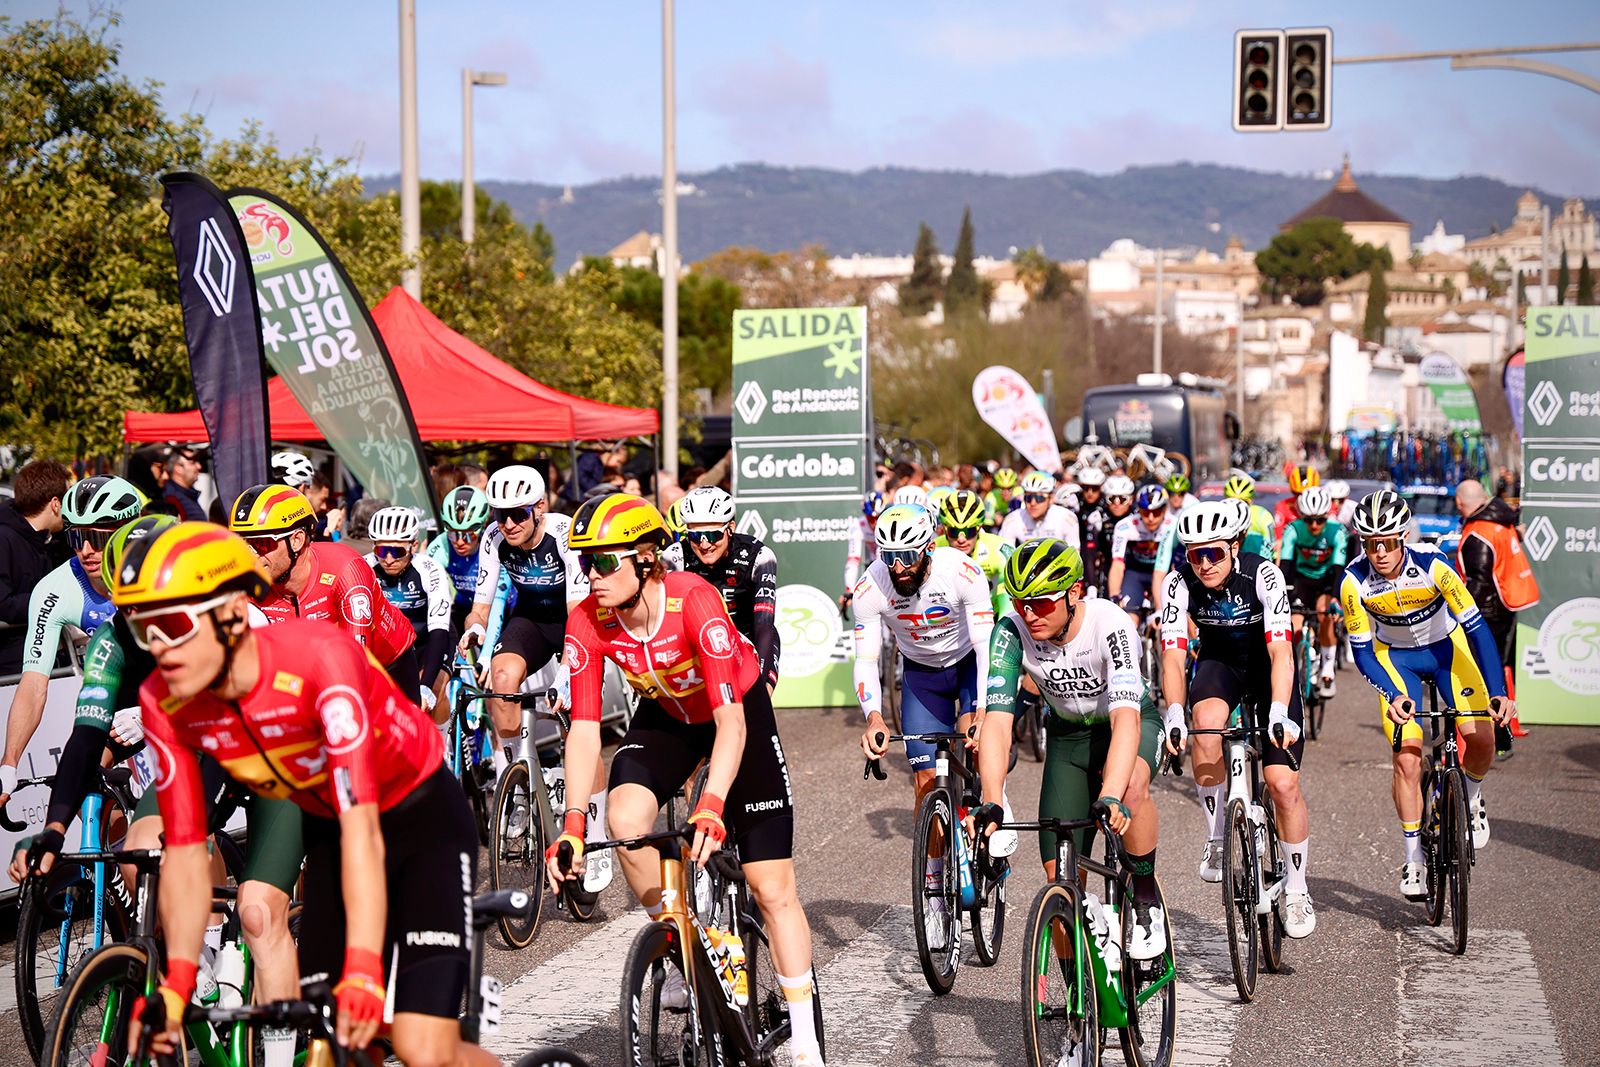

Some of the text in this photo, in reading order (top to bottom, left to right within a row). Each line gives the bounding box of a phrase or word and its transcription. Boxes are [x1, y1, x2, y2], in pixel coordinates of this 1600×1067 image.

[739, 312, 855, 340] SALIDA
[772, 386, 859, 402] Red Renault
[772, 401, 790, 413] de
[741, 452, 855, 478] Córdoba
[287, 507, 306, 521] sweet
[630, 518, 652, 534] sweet
[772, 517, 800, 531] Red
[772, 531, 790, 543] de
[1565, 527, 1596, 541] Red
[1565, 540, 1585, 552] de
[1260, 566, 1278, 591] UBS
[34, 592, 60, 646] DECATHLON
[1390, 604, 1437, 625] baloise
[992, 628, 1014, 668] ALEA
[1106, 631, 1124, 671] RGA
[1117, 628, 1133, 670] SEGUROS
[88, 639, 115, 681] ALEA
[1049, 667, 1091, 681] CAJA
[1043, 677, 1106, 693] RURAL
[745, 800, 783, 813] FUSION
[406, 931, 460, 948] FUSION
